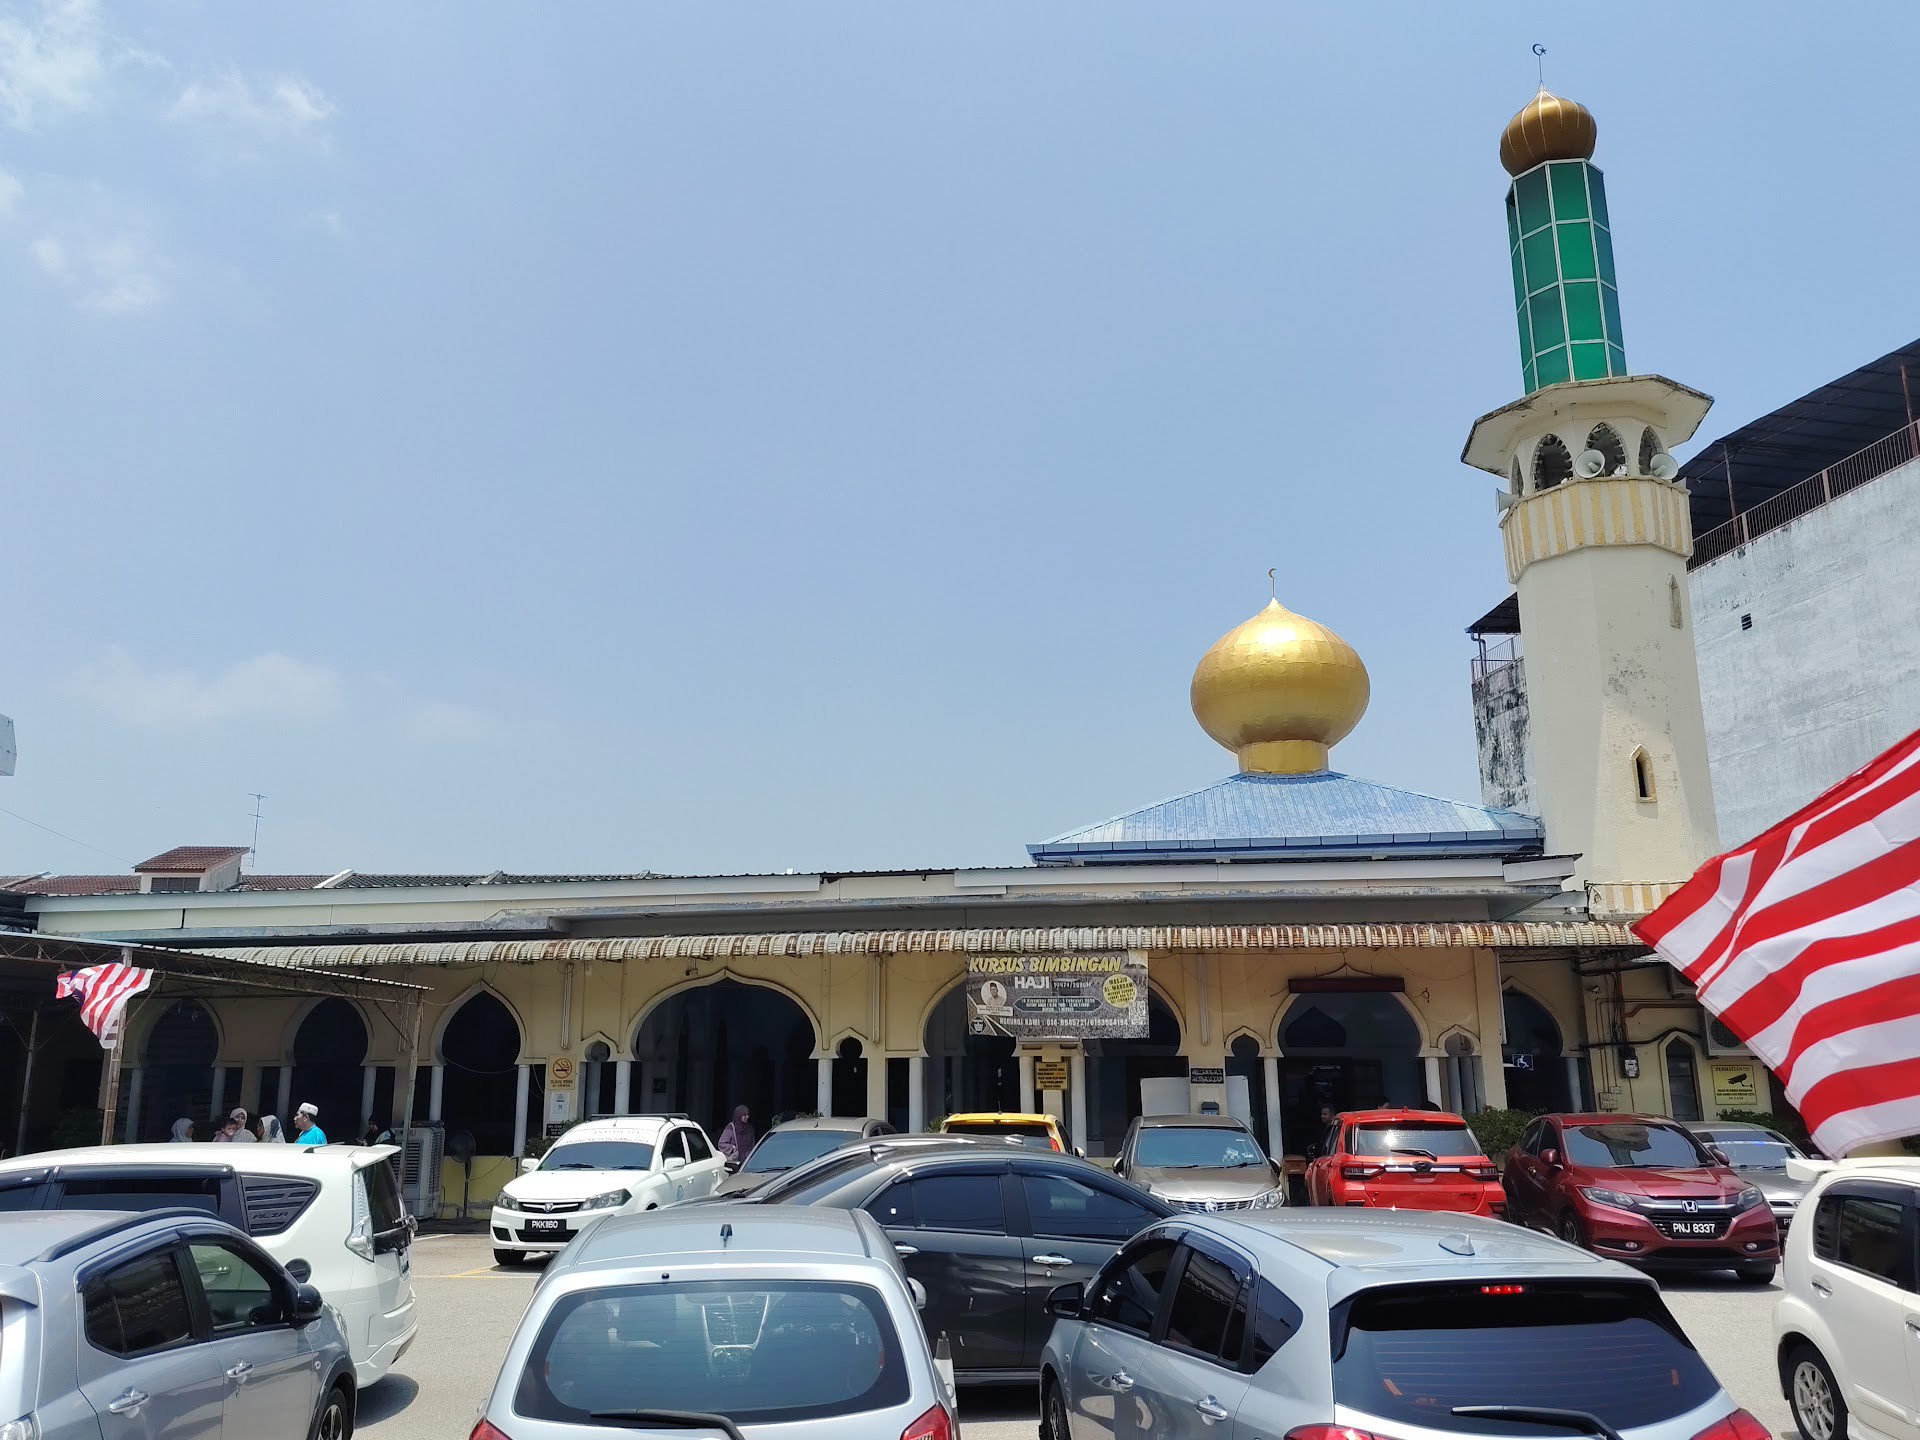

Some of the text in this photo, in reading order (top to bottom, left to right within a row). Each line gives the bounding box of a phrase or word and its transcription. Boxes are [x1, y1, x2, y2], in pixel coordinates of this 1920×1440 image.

[969, 955, 1122, 974] KURSUS BIMBINGAN
[1014, 976, 1050, 989] HAJI
[1672, 1223, 1716, 1233] PNJ 8337
